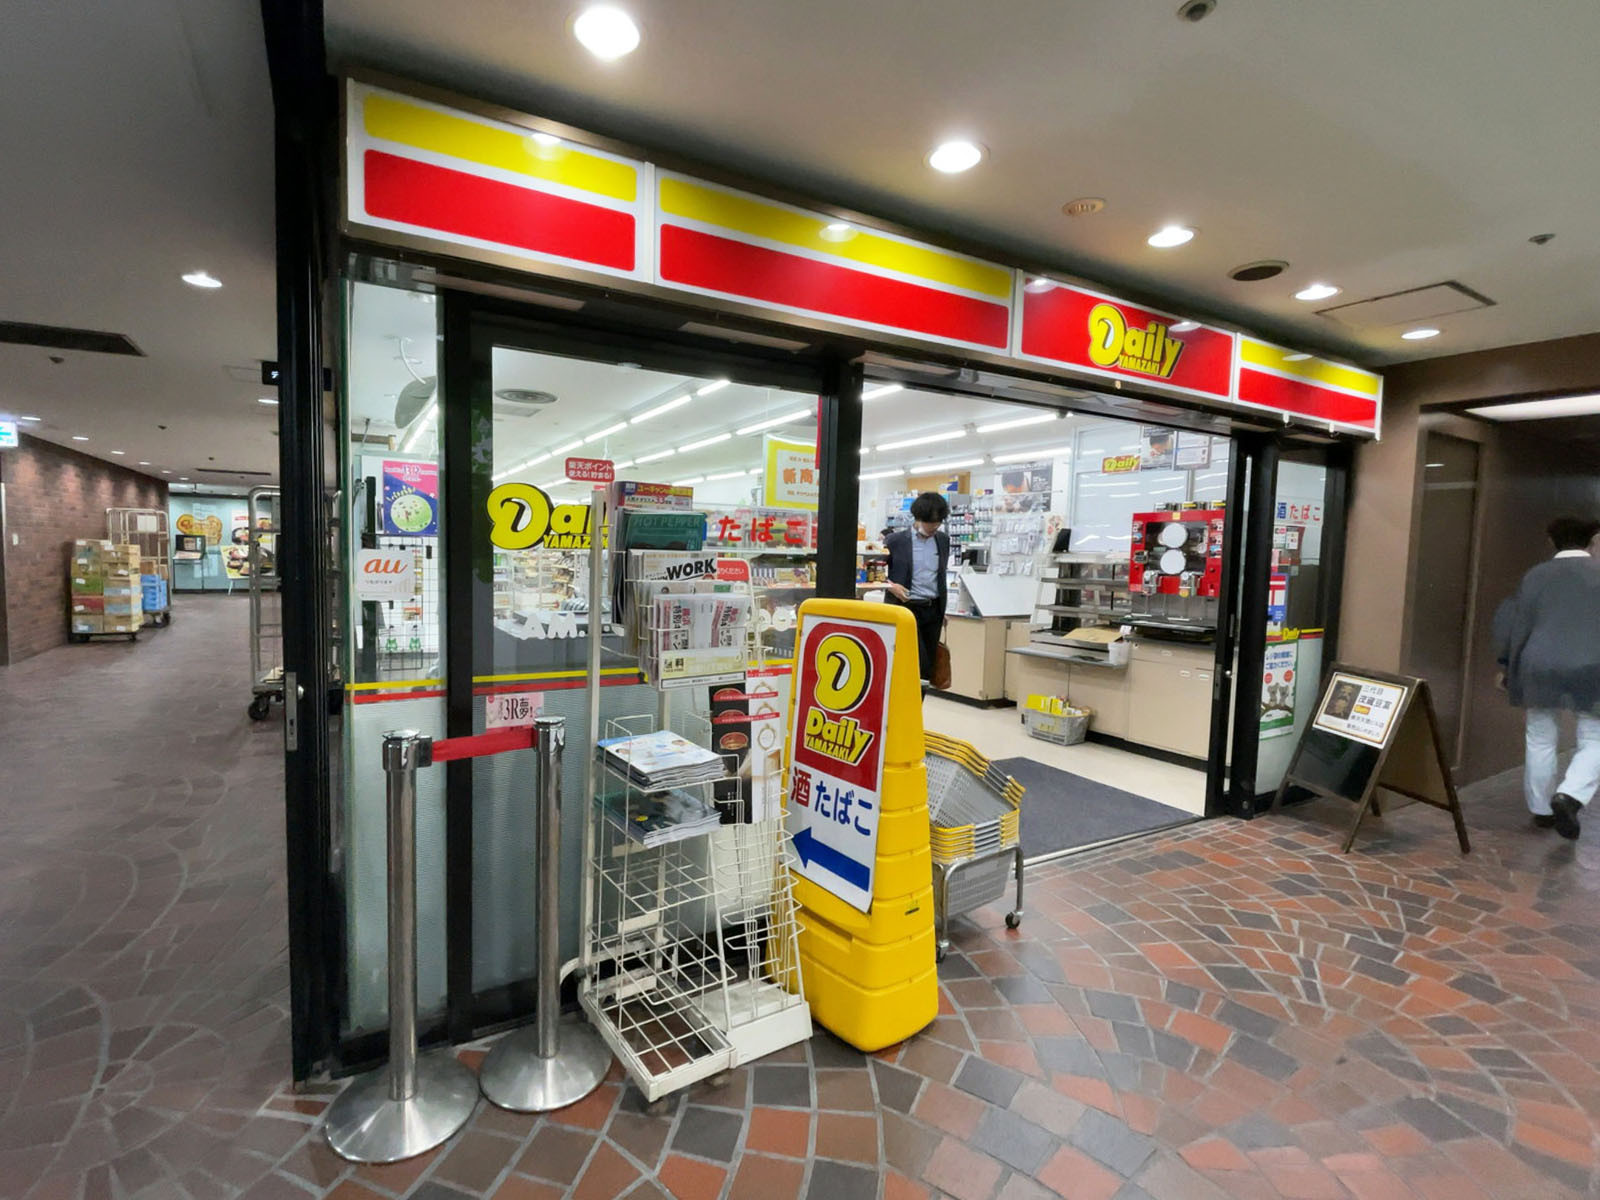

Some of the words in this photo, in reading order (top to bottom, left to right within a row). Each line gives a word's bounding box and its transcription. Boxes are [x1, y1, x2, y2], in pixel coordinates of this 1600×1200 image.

[1089, 304, 1184, 378] Daily
[1119, 354, 1160, 375] YAMAZAKI
[718, 515, 803, 544] たばこ
[364, 559, 408, 574] au
[667, 559, 717, 580] WORK
[806, 708, 872, 764] Daily
[806, 735, 850, 762] YAMAZAKI
[791, 766, 812, 808] 酒
[814, 780, 873, 836] たばこ
